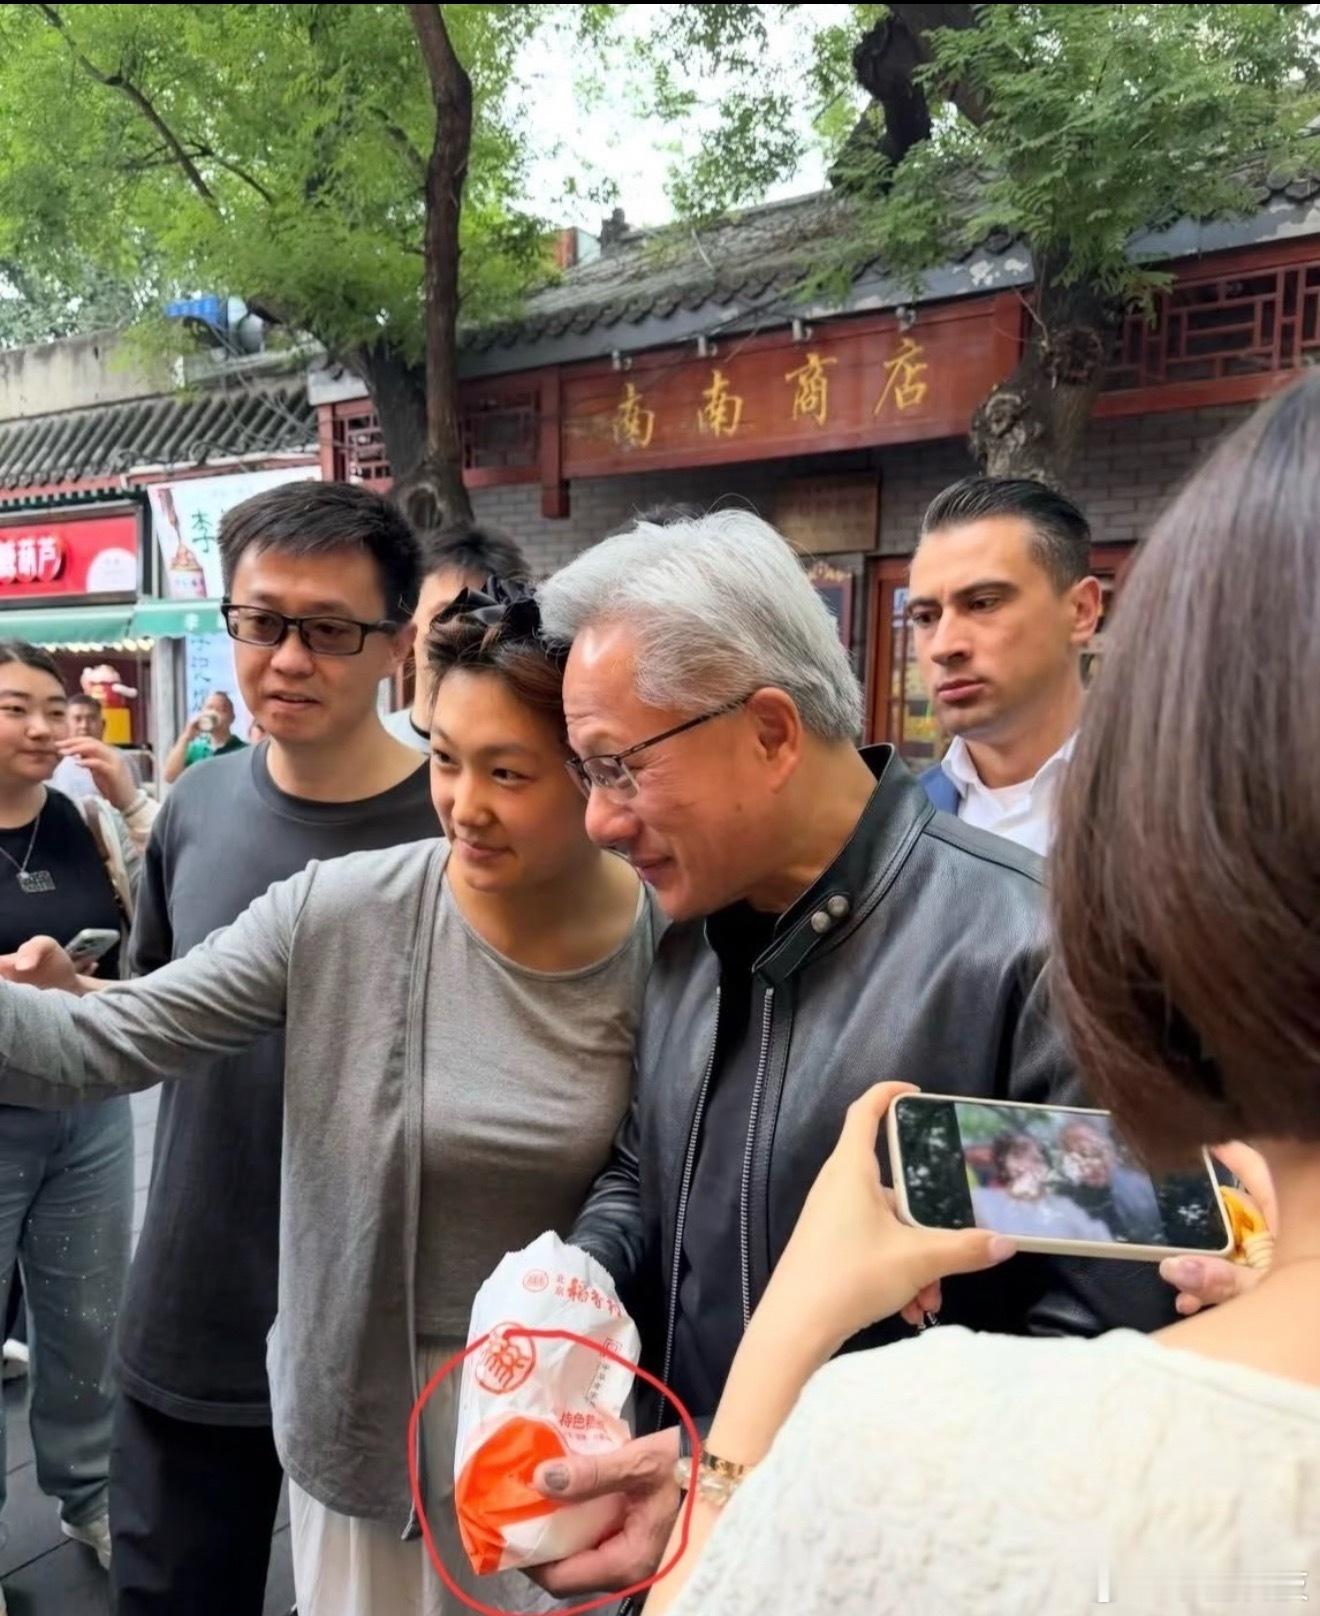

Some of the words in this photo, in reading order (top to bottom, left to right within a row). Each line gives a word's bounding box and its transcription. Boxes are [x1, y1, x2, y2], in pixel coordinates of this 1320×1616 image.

[612, 337, 928, 449] 南南商店
[191, 508, 224, 554] 李
